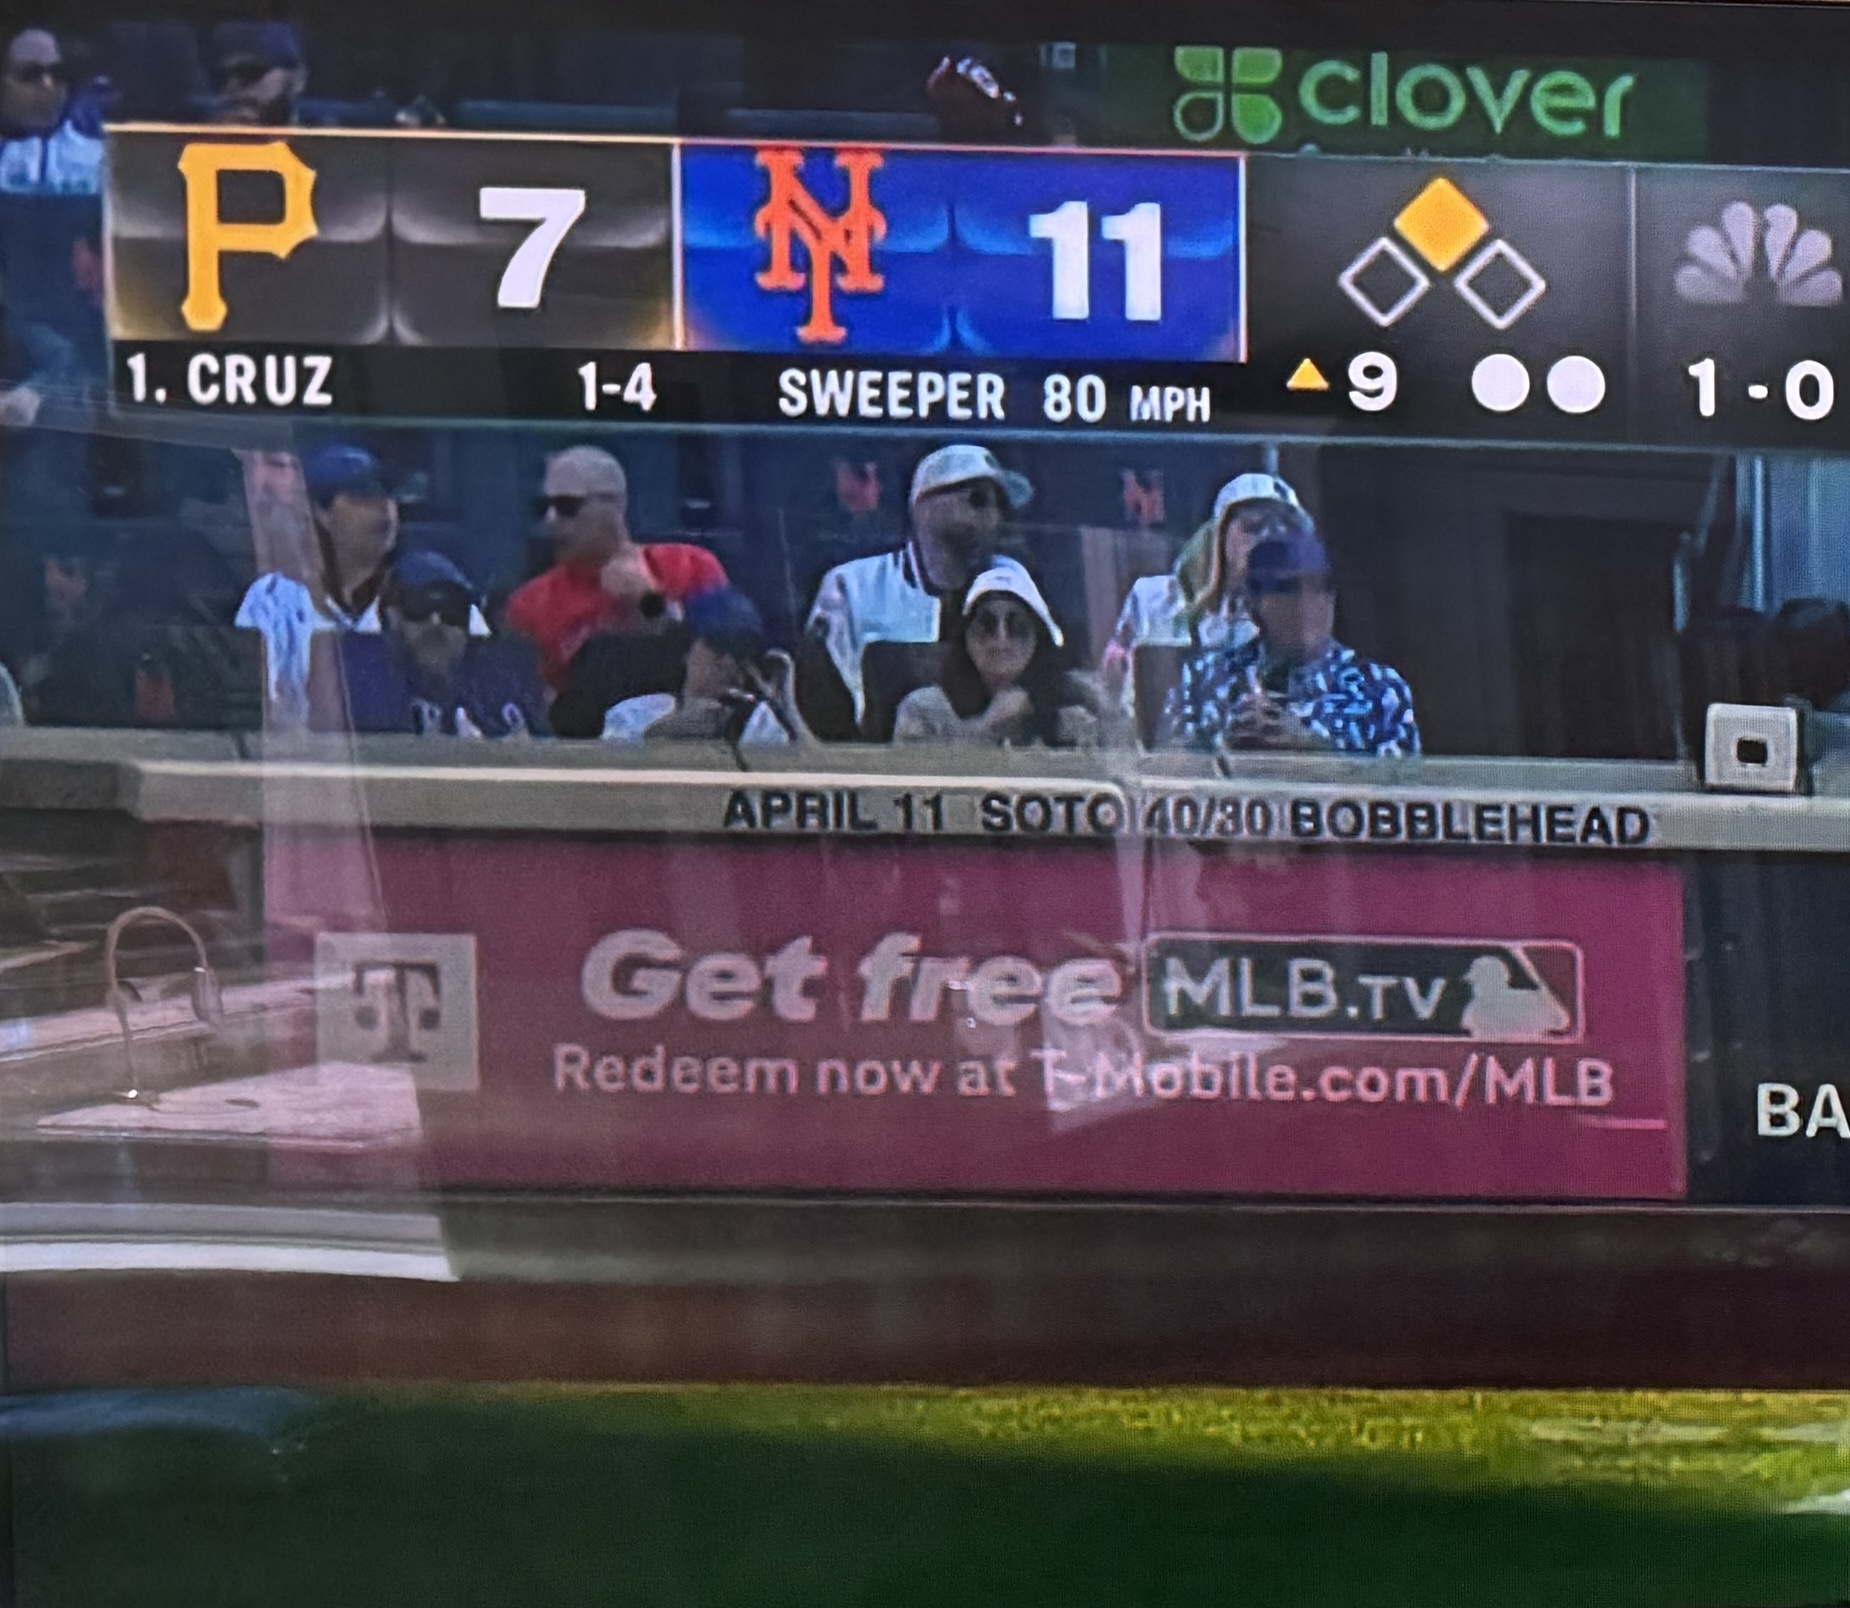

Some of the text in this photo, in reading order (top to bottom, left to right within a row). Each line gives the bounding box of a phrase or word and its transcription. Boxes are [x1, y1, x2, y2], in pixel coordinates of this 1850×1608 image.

[1299, 51, 1637, 140] clover
[178, 141, 318, 331] P
[480, 187, 587, 309] 7
[1028, 200, 1163, 322] 11
[127, 354, 333, 407] 1. CRUZ
[578, 362, 657, 412] 1-4
[778, 368, 1211, 424] SWEEPER 80 MPH
[1347, 352, 1399, 412] 9
[723, 790, 1652, 846] APRIL 11 SOTO 40/30 BOBBLEHEAD
[581, 927, 1446, 1026] Get free MLB.TV
[554, 1042, 1615, 1108] Redeem now at T-Mobile.com/MLB
